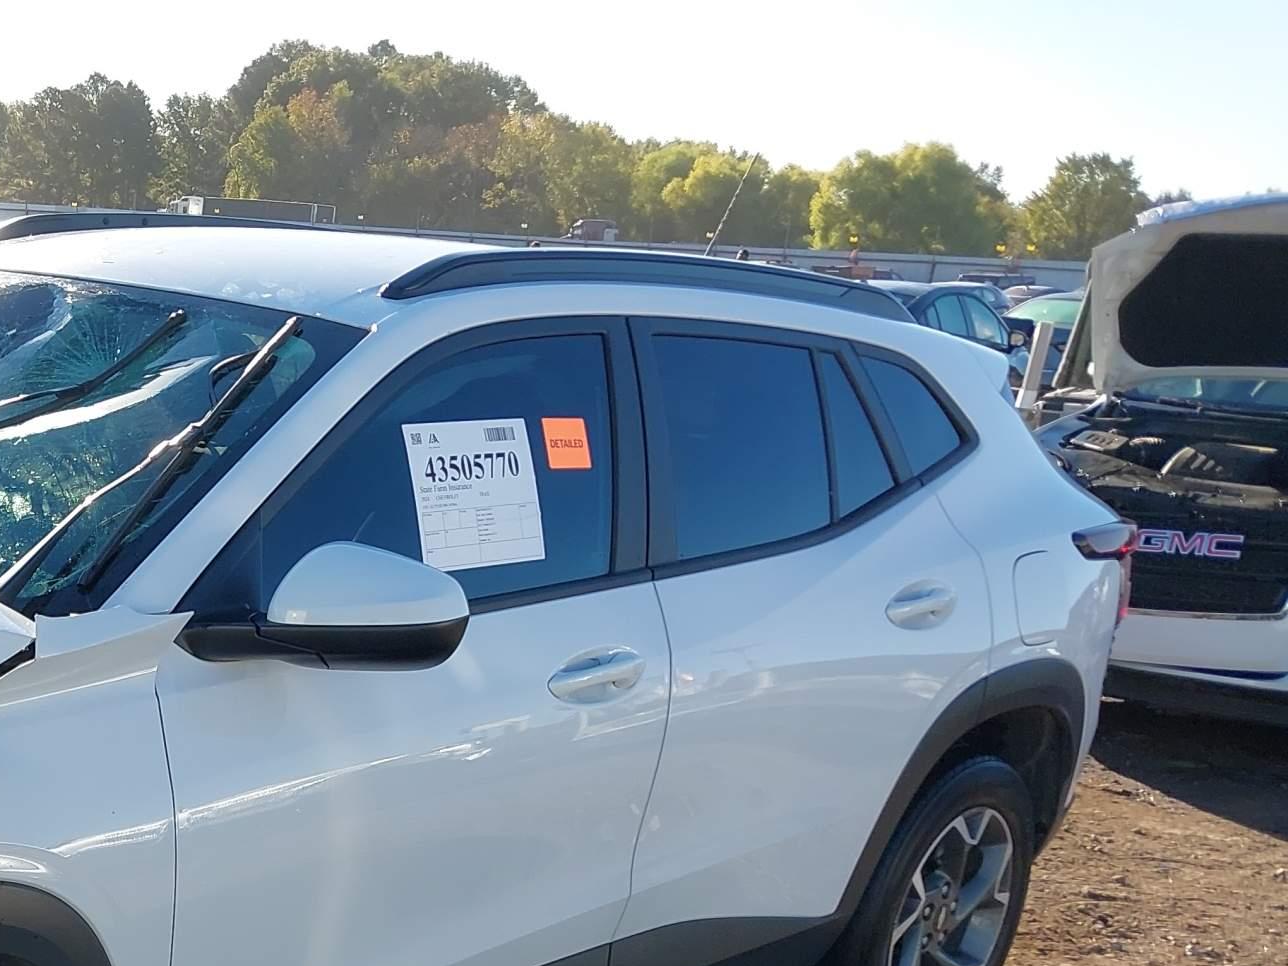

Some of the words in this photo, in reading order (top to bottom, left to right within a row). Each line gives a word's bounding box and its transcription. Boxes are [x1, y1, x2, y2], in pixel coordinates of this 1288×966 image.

[550, 439, 584, 449] DETAILED
[425, 451, 520, 483] 43505770
[434, 484, 448, 493] Farm
[448, 483, 473, 492] Insurance
[1136, 528, 1245, 560] GMC
